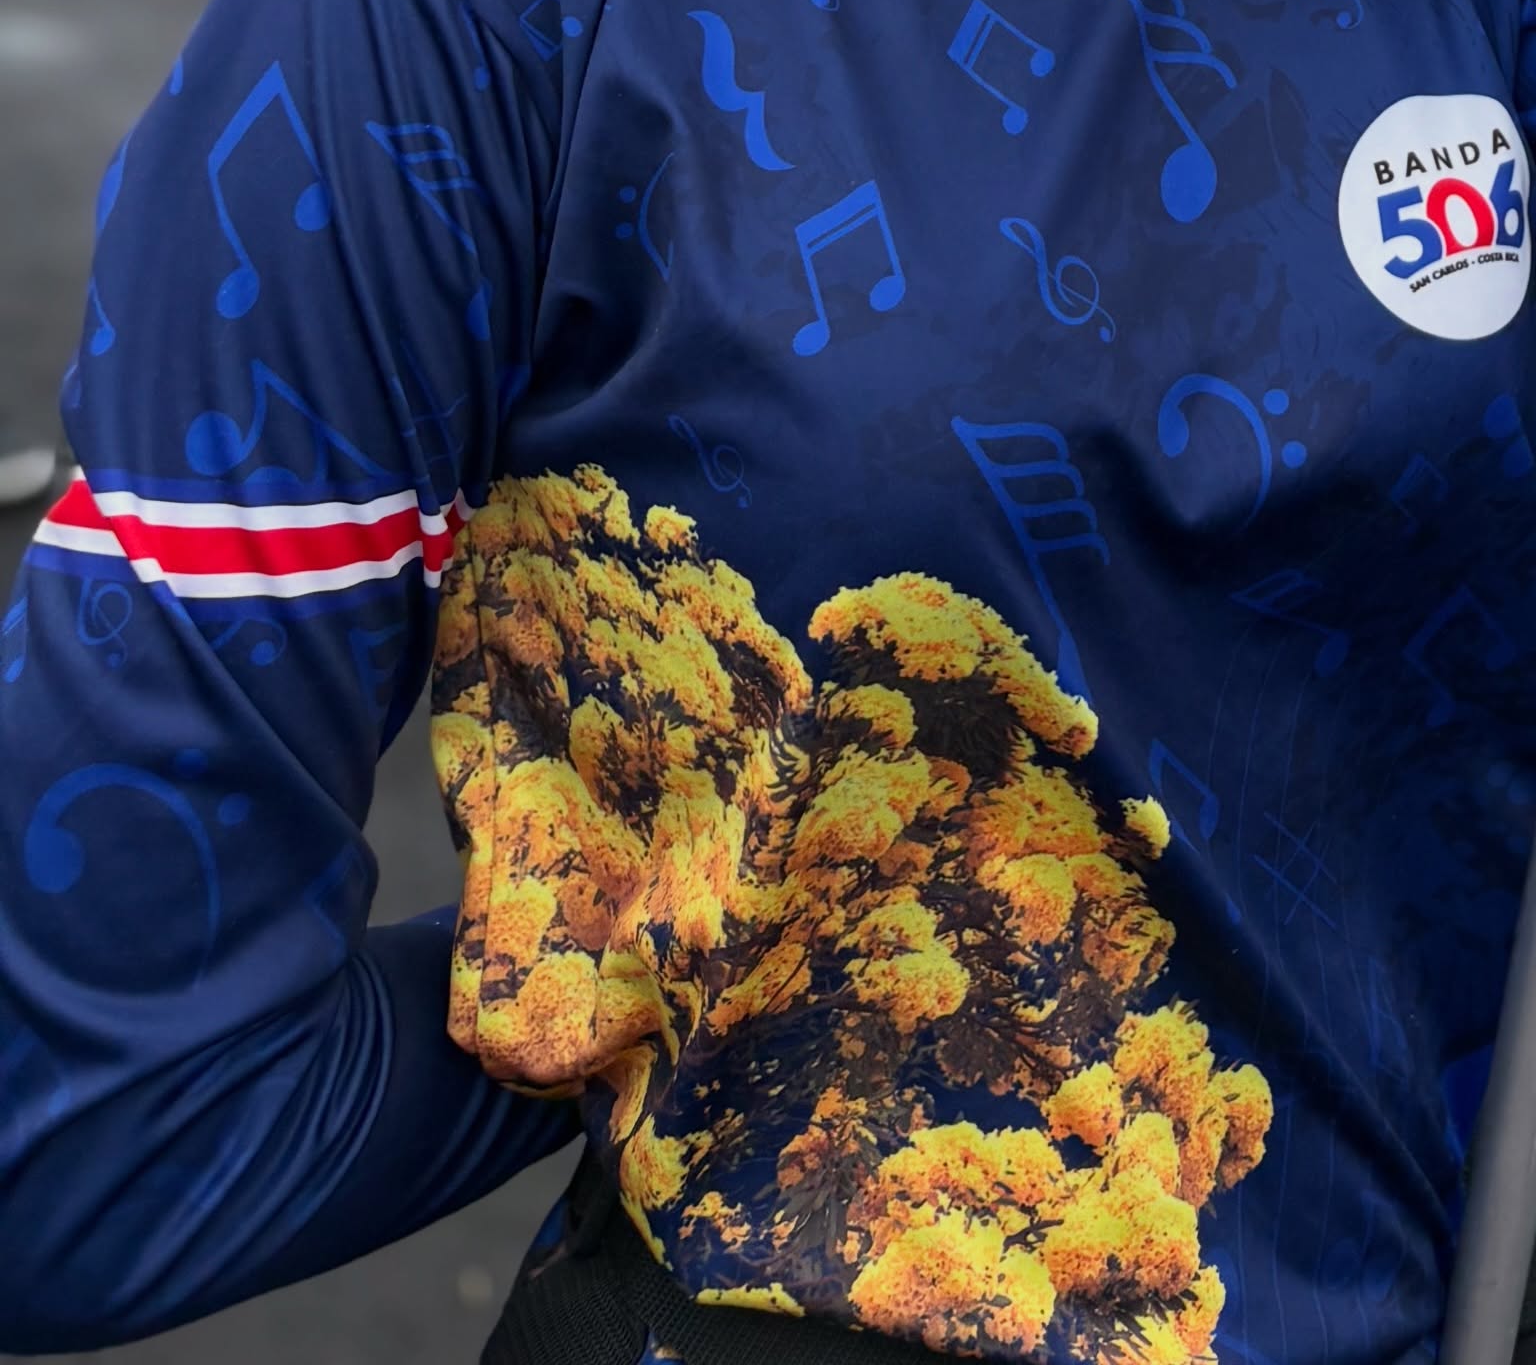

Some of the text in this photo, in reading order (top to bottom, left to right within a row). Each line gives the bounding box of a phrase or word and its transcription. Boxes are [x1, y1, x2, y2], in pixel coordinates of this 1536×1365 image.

[1373, 128, 1511, 185] BANDA
[1377, 159, 1525, 280] 506
[1410, 275, 1431, 293] SAN
[1432, 259, 1469, 280] CARLOS
[1477, 252, 1503, 265] COSTA
